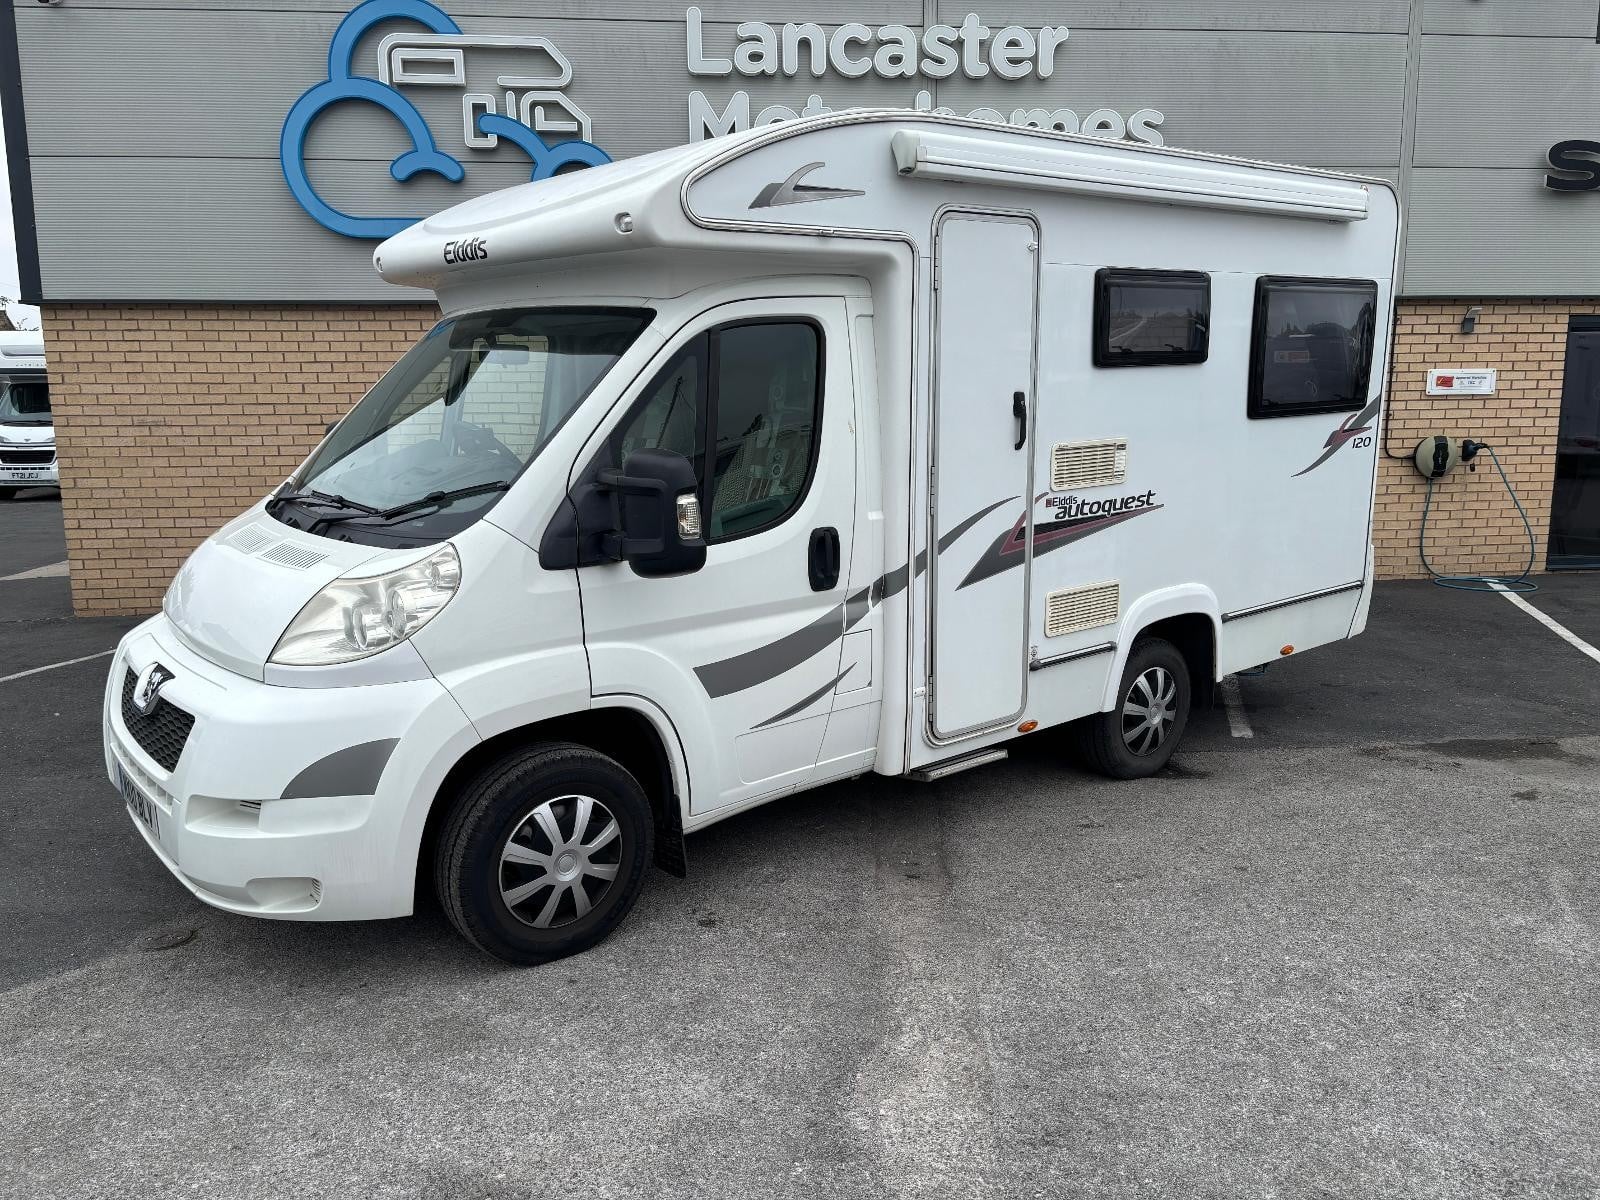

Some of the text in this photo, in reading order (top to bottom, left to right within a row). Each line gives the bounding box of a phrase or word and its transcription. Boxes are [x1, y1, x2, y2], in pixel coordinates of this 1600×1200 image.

[686, 6, 1069, 80] Lancaster
[443, 237, 488, 265] Elddis
[1351, 436, 1372, 449] 120
[1052, 495, 1078, 507] Elddis
[1054, 489, 1156, 520] autoquest
